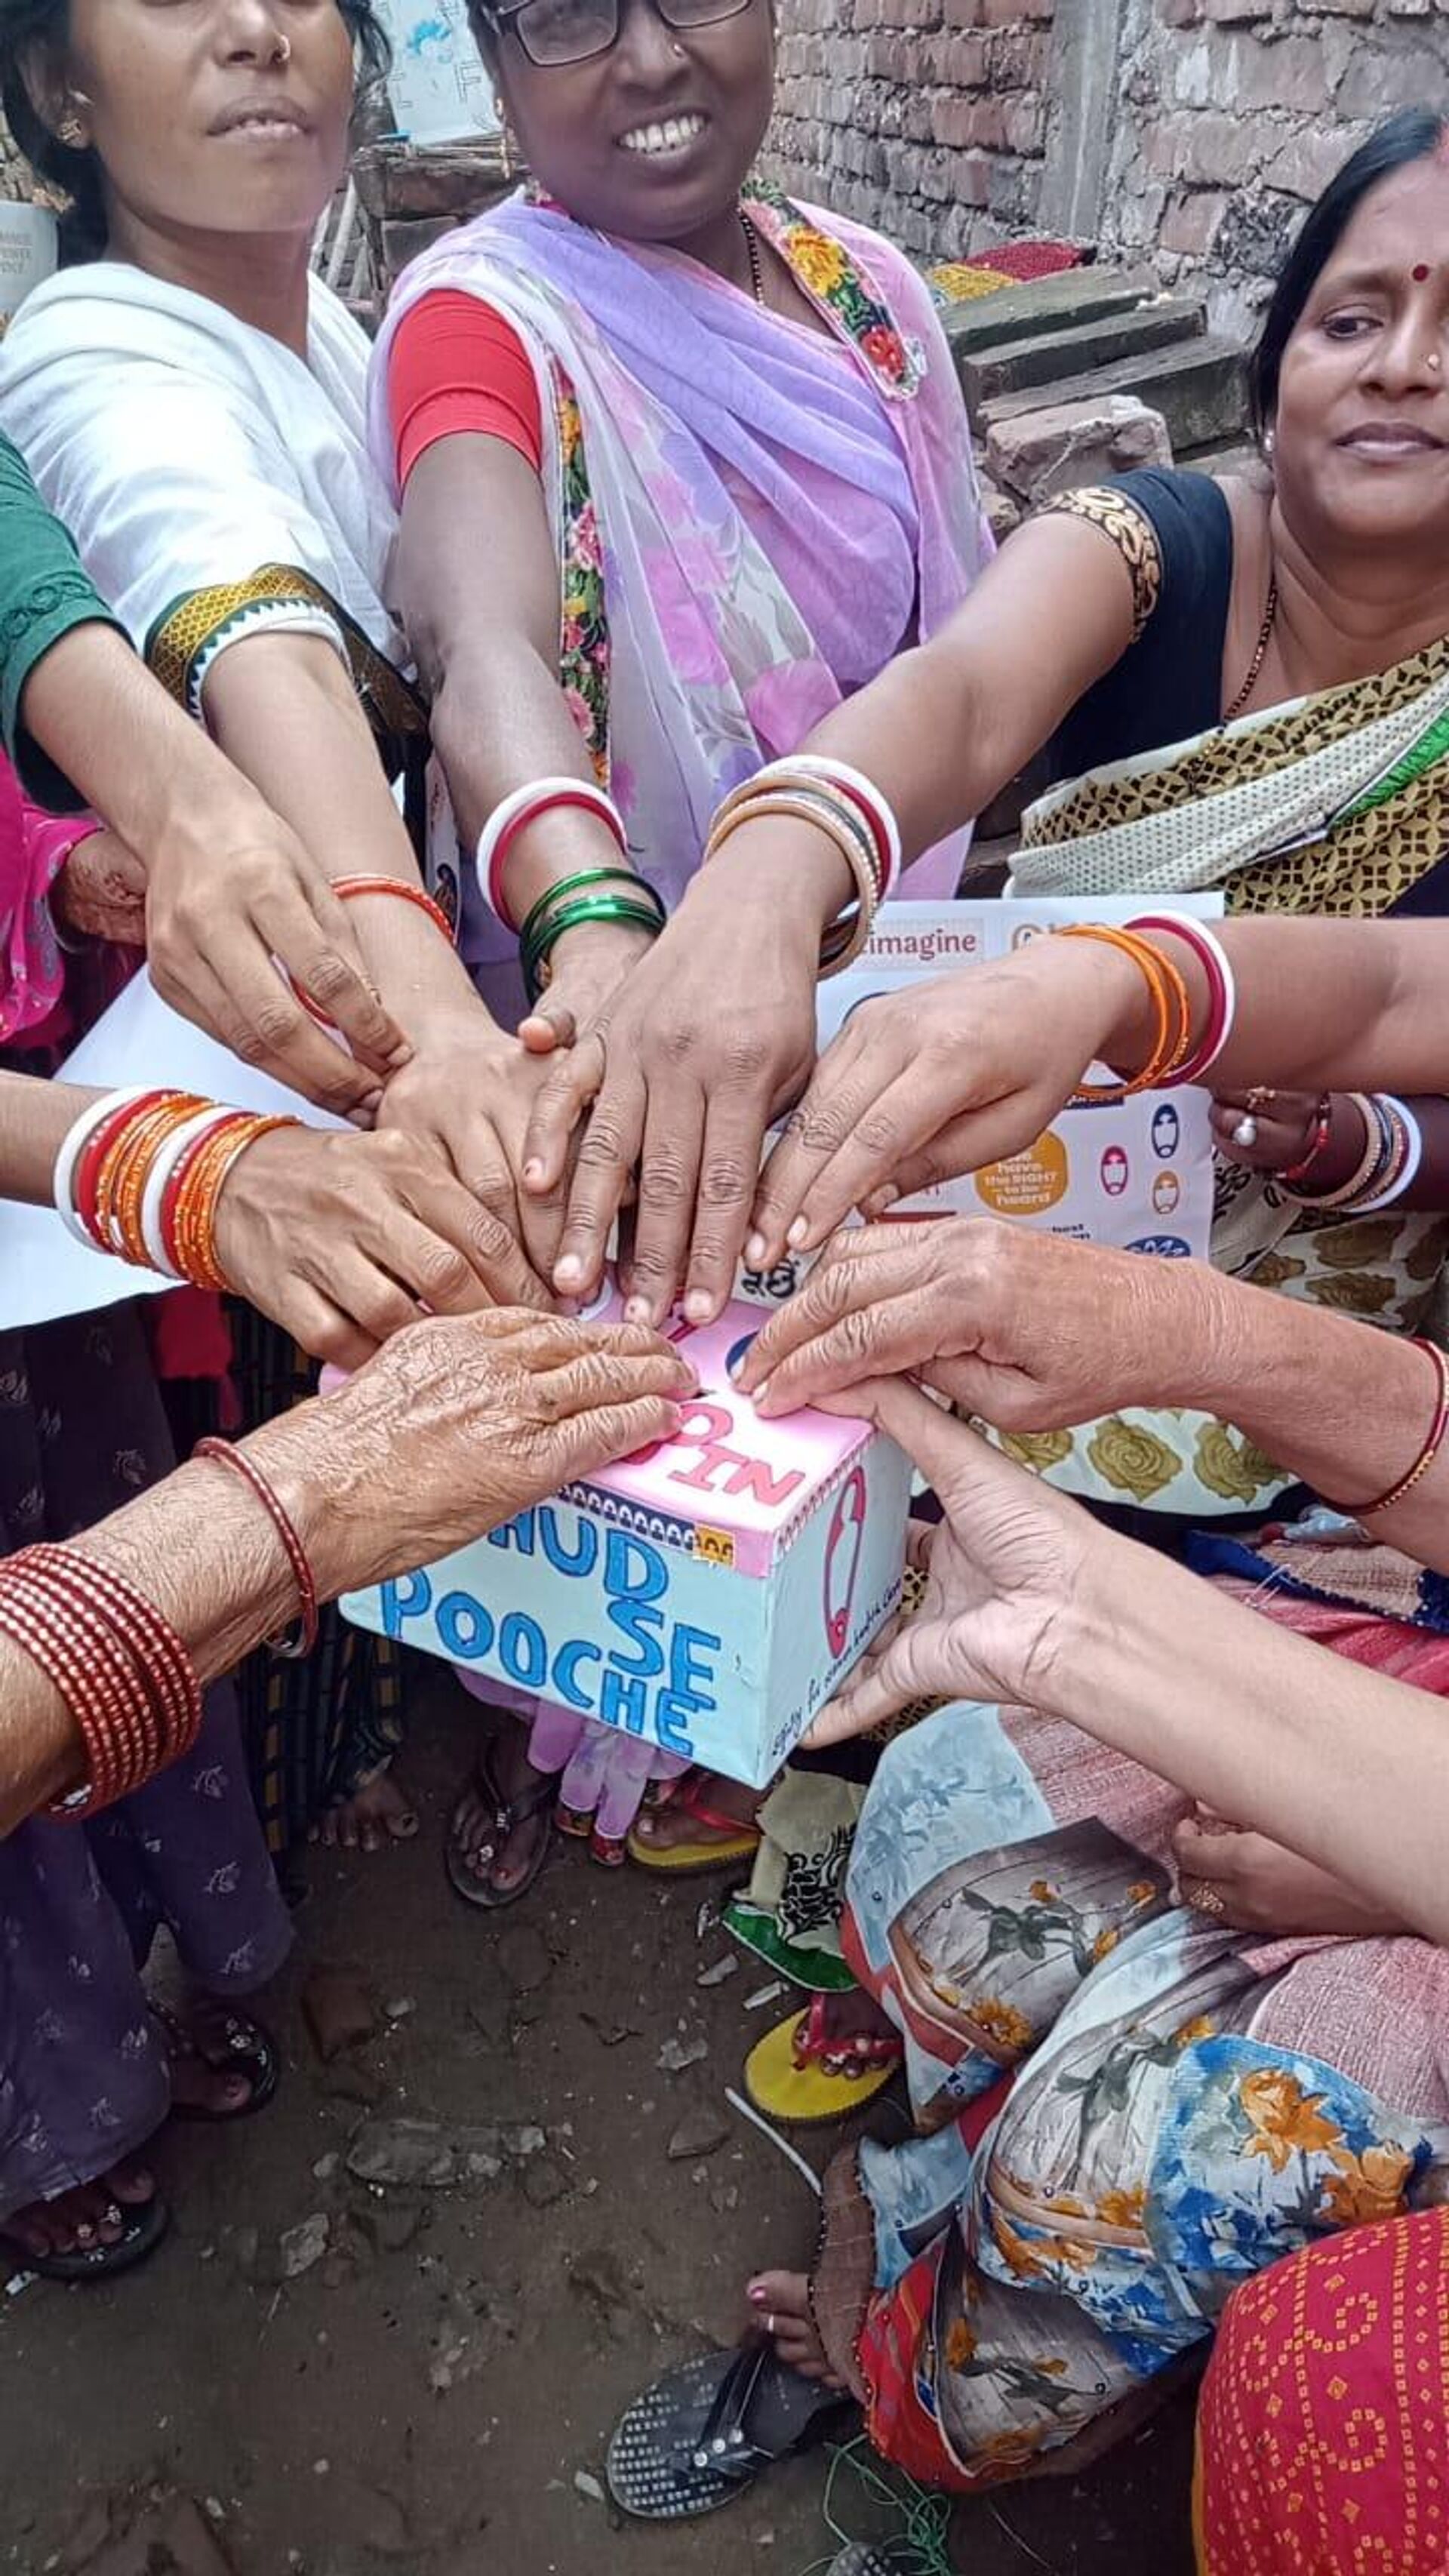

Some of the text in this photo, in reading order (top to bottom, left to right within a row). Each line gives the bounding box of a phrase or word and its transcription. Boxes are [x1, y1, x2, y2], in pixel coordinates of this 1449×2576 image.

[862, 928, 977, 961] imagine
[380, 1568, 695, 1758] POOCHE
[607, 1598, 721, 1711] SE
